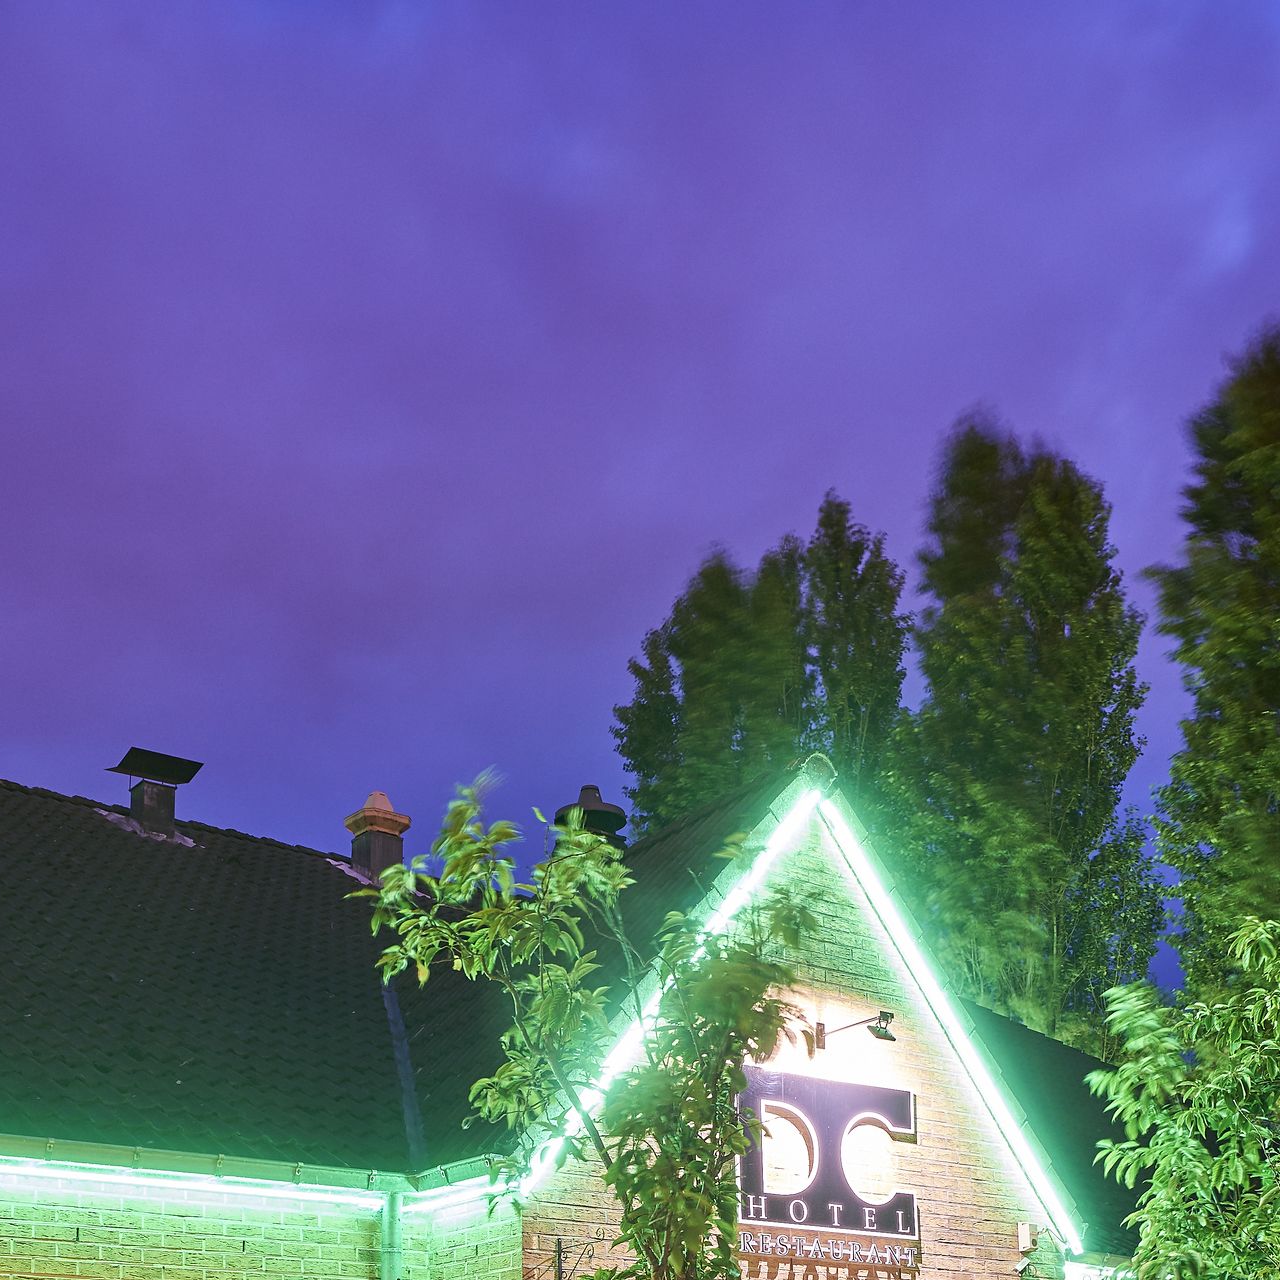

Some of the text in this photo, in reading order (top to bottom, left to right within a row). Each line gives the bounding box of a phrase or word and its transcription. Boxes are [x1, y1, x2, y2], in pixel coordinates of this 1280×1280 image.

[736, 1065, 918, 1212] DC
[746, 1194, 911, 1234] HOTEL
[738, 1231, 918, 1269] RESTAURANT
